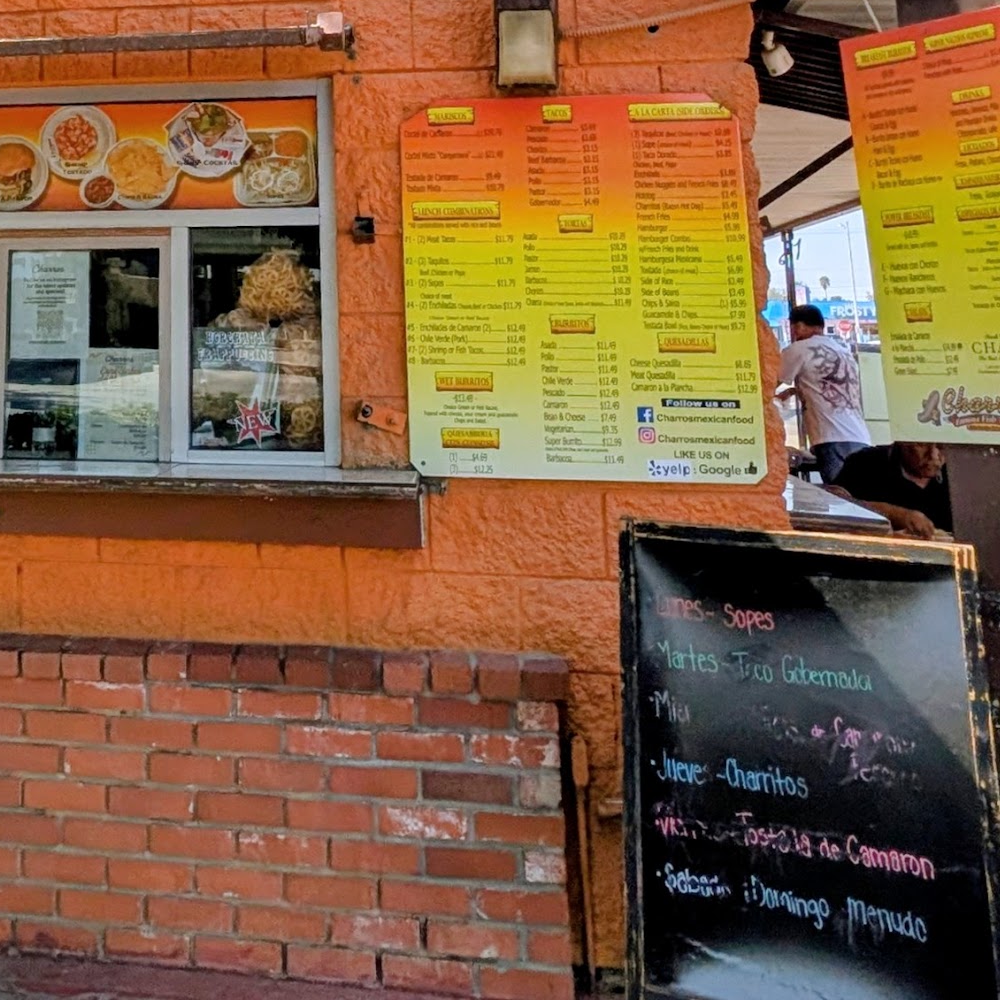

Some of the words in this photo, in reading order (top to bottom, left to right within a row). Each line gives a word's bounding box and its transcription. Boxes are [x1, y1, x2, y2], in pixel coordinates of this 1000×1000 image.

[666, 399, 703, 407] Follow
[721, 401, 737, 409] on
[236, 410, 273, 432] NEW
[656, 413, 755, 425] Charrosmexicanfood
[657, 434, 756, 446] Charrosmexicanfood
[673, 450, 696, 459] LIKE
[698, 451, 712, 460] US
[714, 451, 730, 460] ON
[661, 463, 691, 477] yelp
[699, 464, 742, 476] Google
[723, 603, 775, 636] Sopes
[847, 835, 935, 880] Camaron
